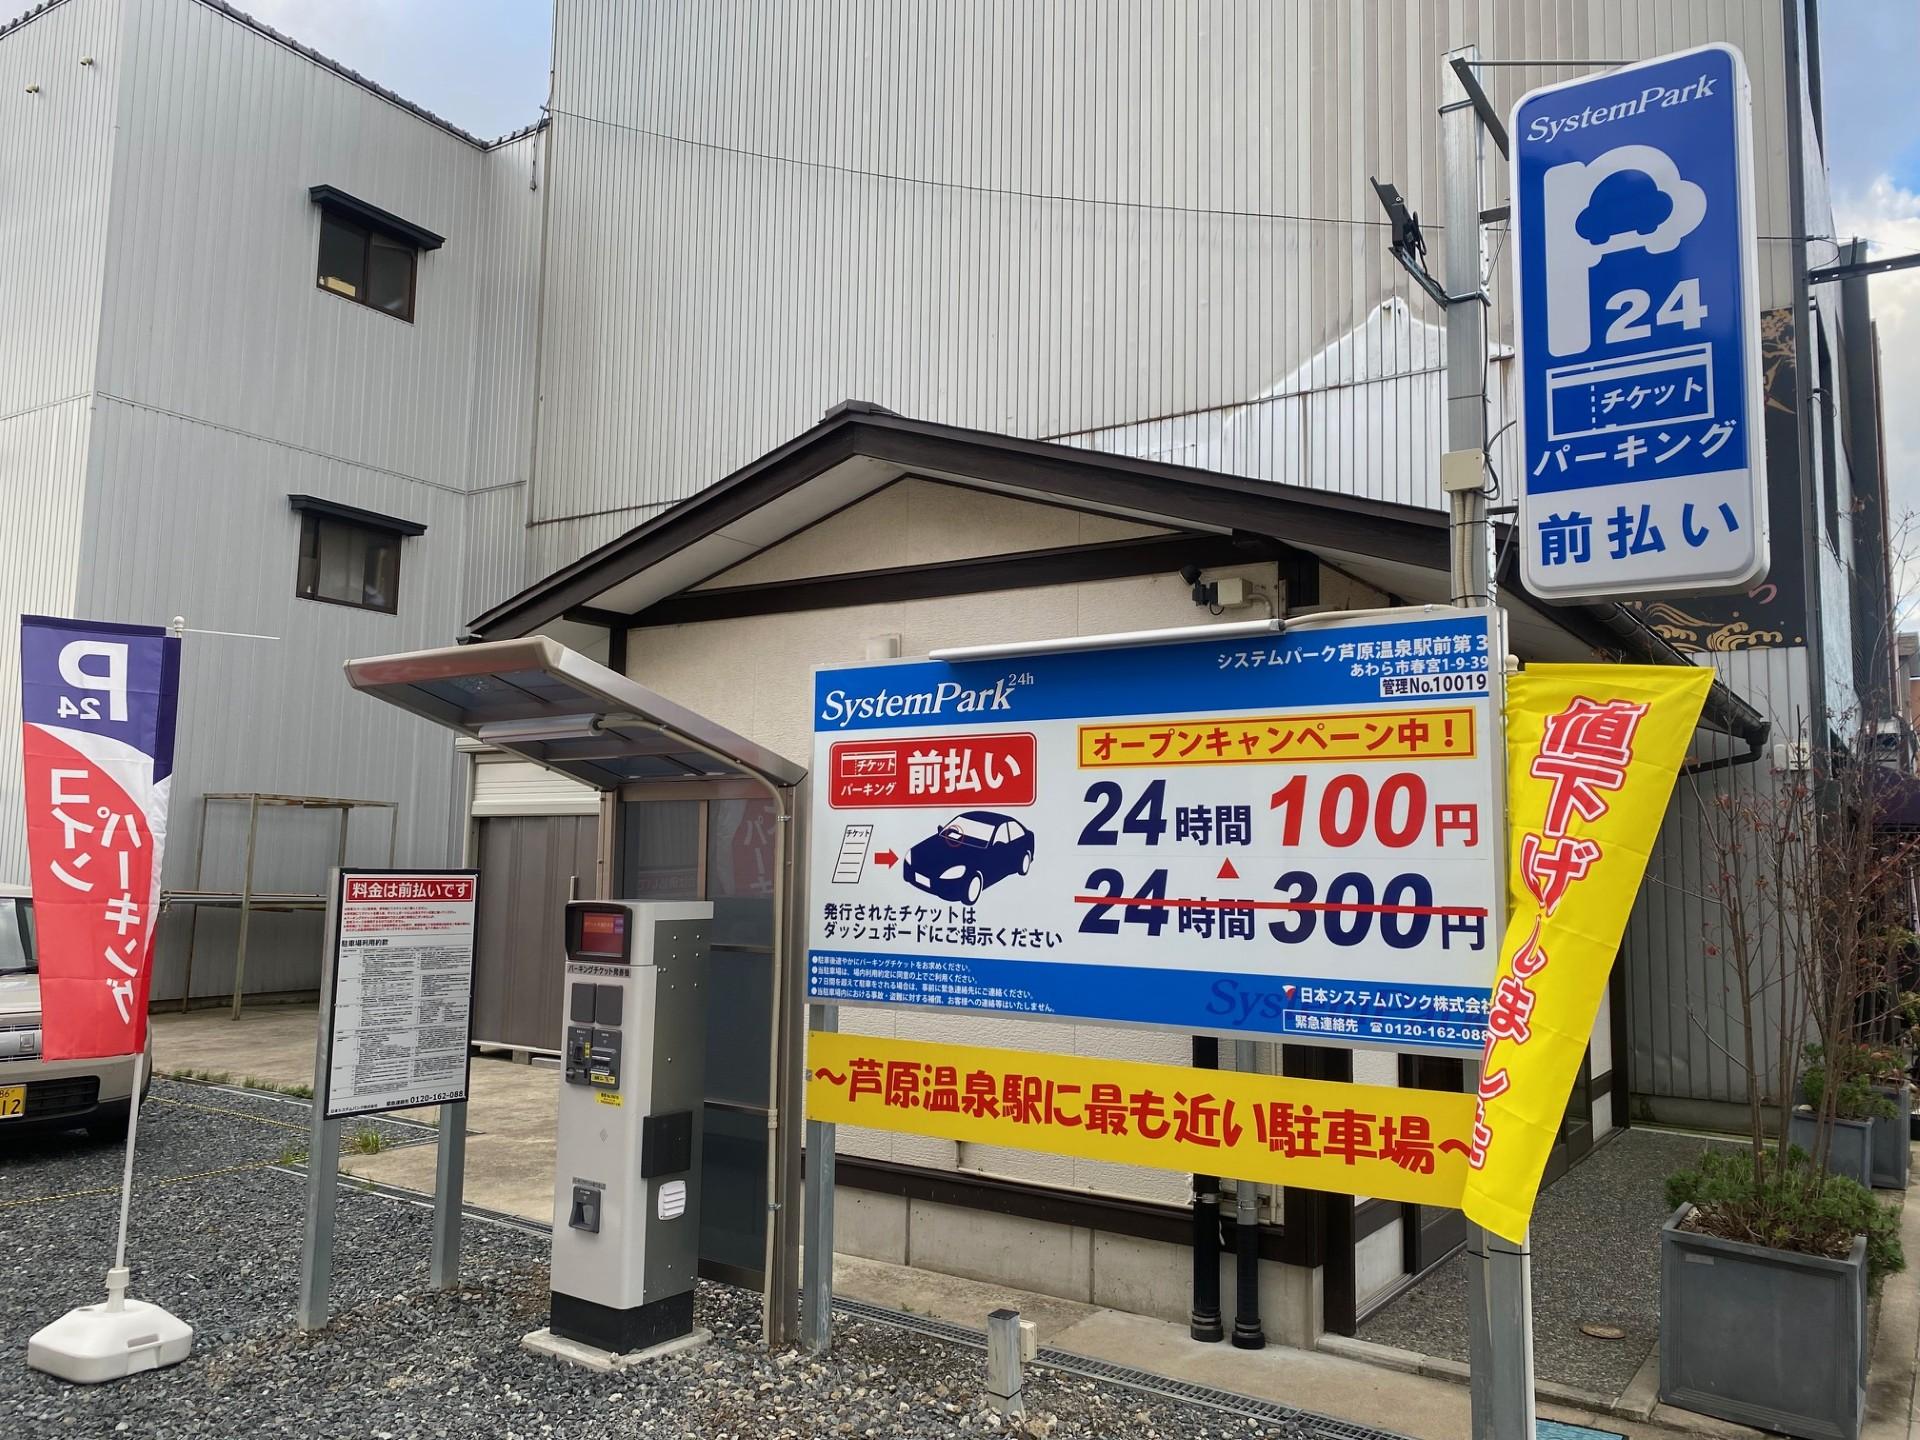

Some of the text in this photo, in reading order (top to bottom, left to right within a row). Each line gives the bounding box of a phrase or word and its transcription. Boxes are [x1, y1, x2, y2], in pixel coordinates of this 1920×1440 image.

[1527, 74, 1718, 143] SystemPark
[1604, 277, 1709, 345] 24
[1601, 376, 1704, 414] チケット
[1533, 419, 1738, 477] パーキング
[1538, 502, 1740, 567] 前払い
[1350, 655, 1489, 678] あわら市春宮1-9-39
[1382, 674, 1487, 696] 管理No.10019
[821, 679, 1016, 727] SystemPark
[856, 757, 896, 775] チケット
[907, 747, 1022, 795] 前払い
[841, 780, 897, 797] パーキング
[1269, 772, 1480, 849] 100円
[352, 881, 470, 899] 料金は前払いです
[823, 902, 977, 924] 発行されたチケットは
[823, 920, 1063, 949] ダッシュボードにご掲示ください
[1295, 1014, 1359, 1034] 緊急連絡先
[410, 1090, 464, 1104] 0120-162-088
